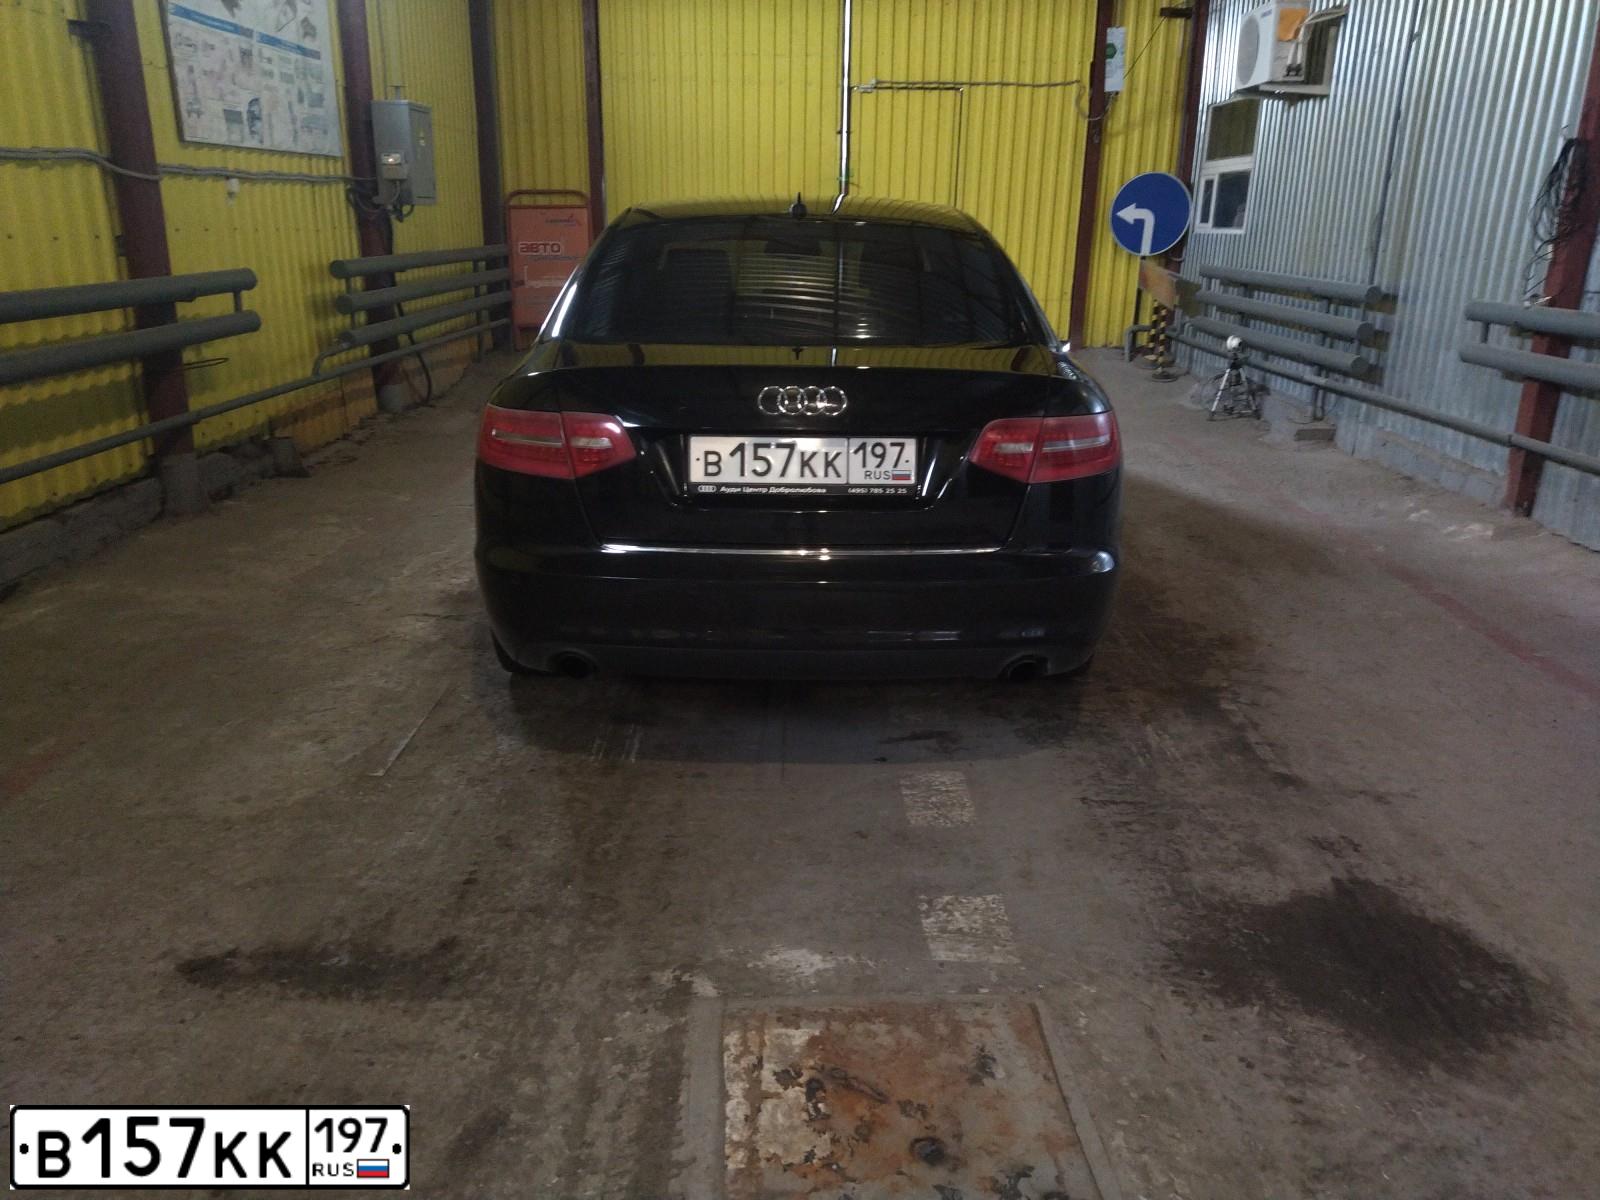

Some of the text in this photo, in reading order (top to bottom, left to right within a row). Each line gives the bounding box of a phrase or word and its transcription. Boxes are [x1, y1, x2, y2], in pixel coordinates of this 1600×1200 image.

[852, 442, 906, 469] 197
[864, 470, 890, 480] RUS
[720, 486, 908, 495] Ауди Центр Добролюбова (495) 785 25 25
